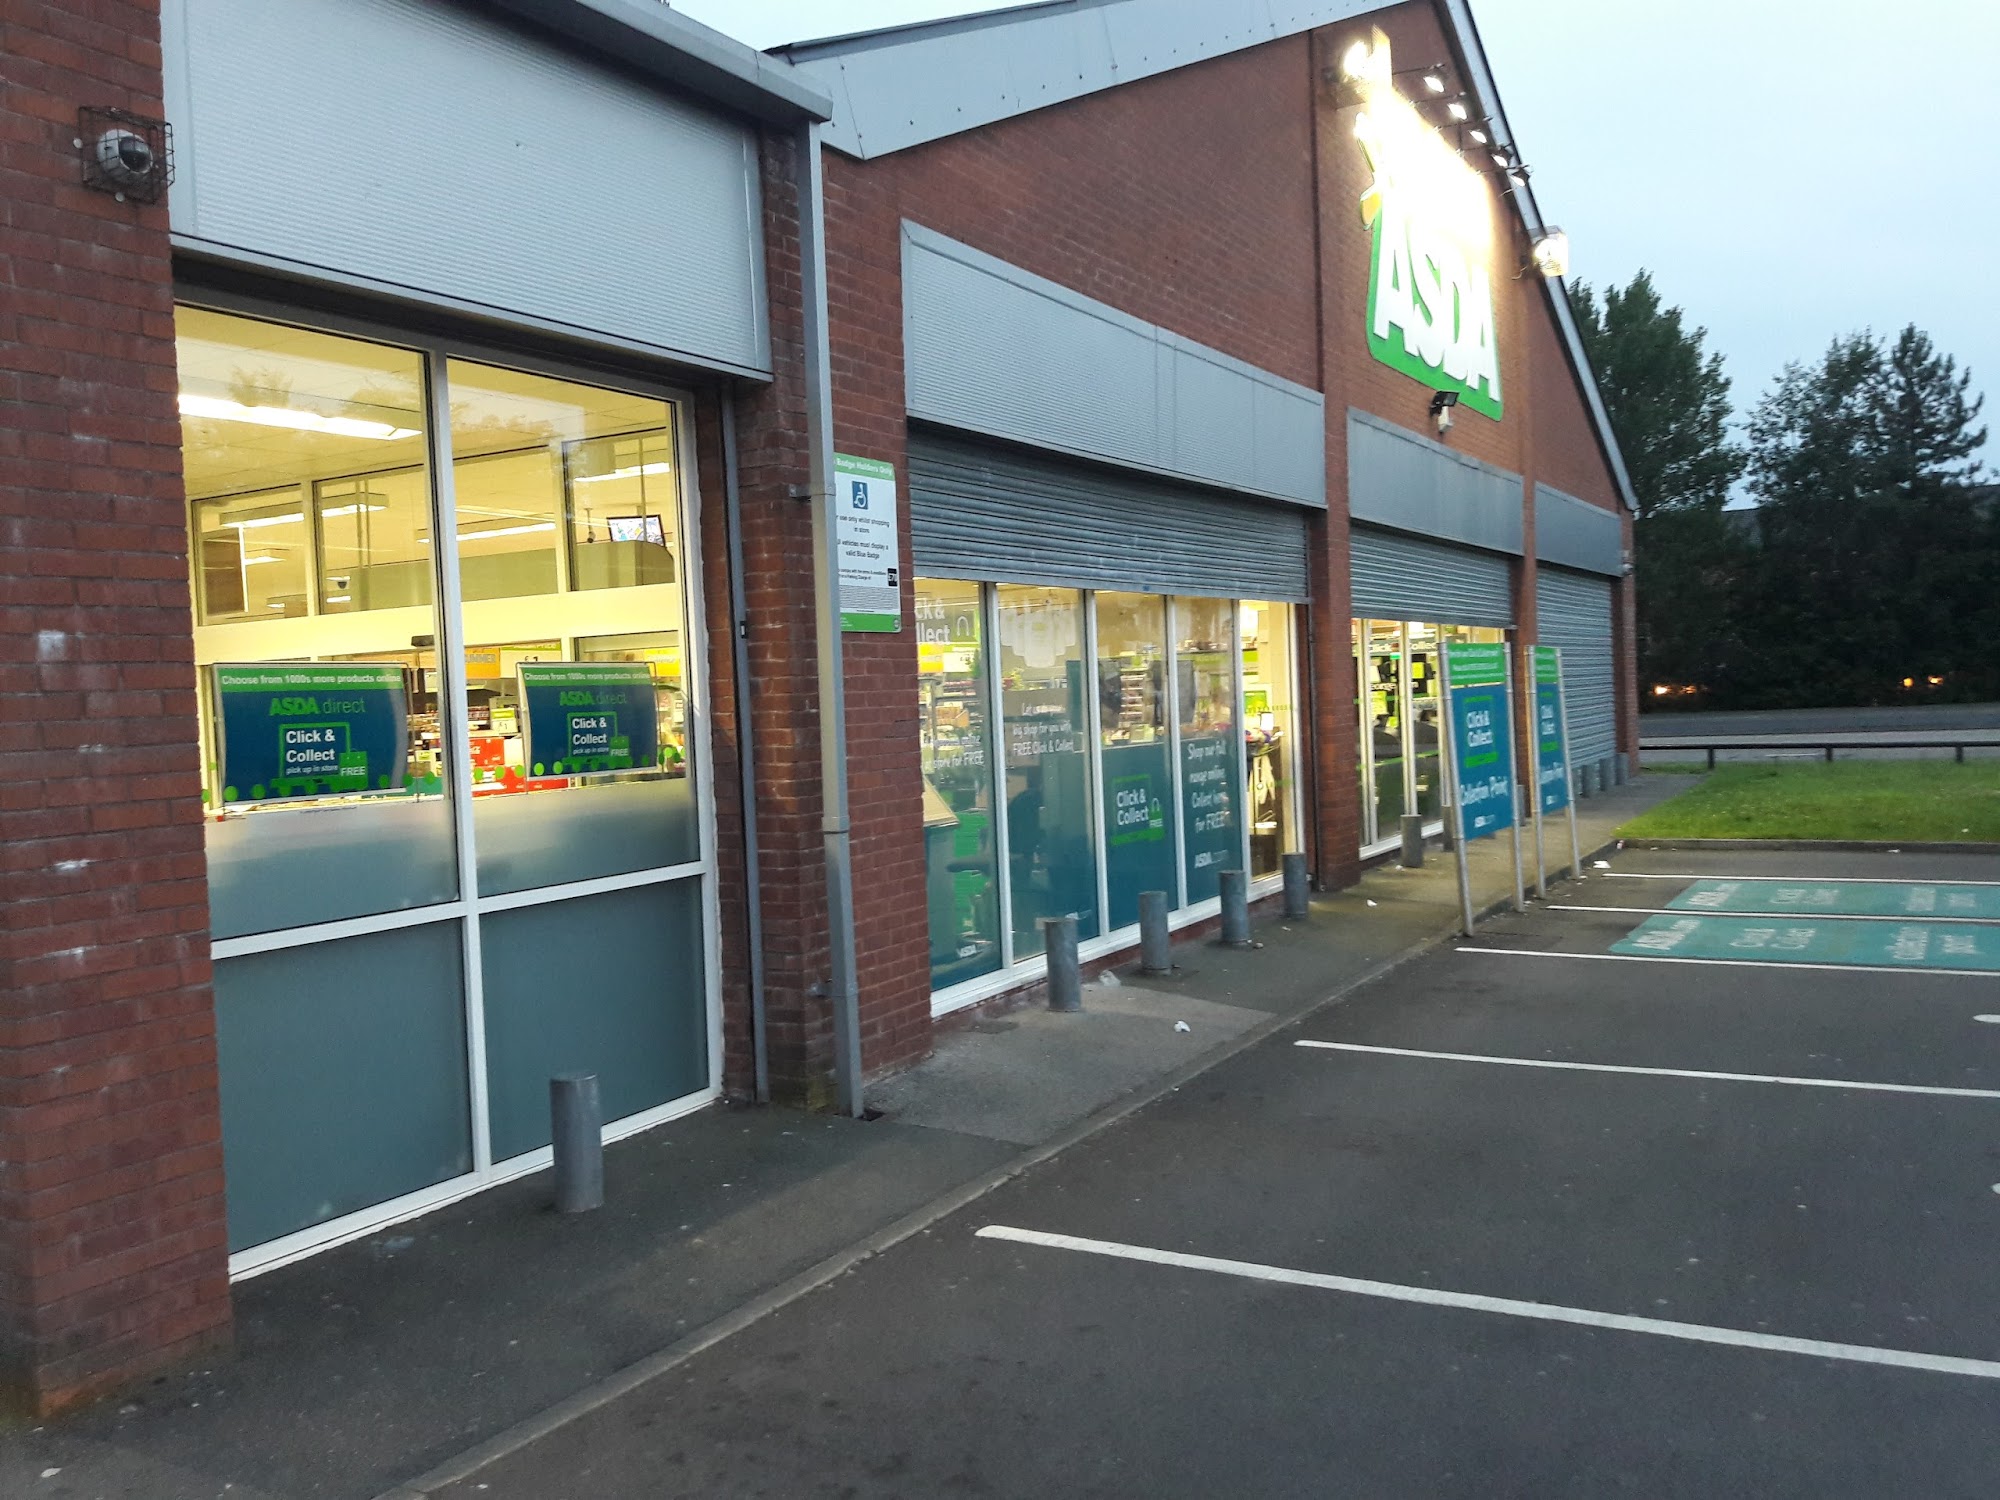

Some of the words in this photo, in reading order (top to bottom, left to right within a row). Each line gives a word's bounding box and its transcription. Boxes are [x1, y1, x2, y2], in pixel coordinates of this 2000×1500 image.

[1372, 185, 1501, 403] ASDA
[916, 622, 951, 645] llect
[222, 675, 259, 685] Choose
[260, 675, 283, 684] from
[285, 674, 311, 684] 1000s
[337, 675, 375, 685] products
[376, 674, 401, 682] online
[524, 672, 550, 681] Choose
[550, 672, 566, 680] from
[604, 673, 631, 681] products
[632, 672, 651, 680] online
[269, 696, 321, 716] ASDA
[322, 697, 366, 714] direct
[559, 690, 595, 706] ASDA
[572, 718, 597, 729] Click
[599, 717, 607, 728] &
[286, 730, 321, 744] Click
[324, 729, 335, 742] &
[572, 733, 607, 746] Collect
[1467, 729, 1493, 748] Collect
[610, 748, 629, 757] FREE
[1013, 741, 1033, 756] FREE
[1048, 739, 1054, 753] &
[1055, 738, 1074, 752] Collect
[286, 748, 336, 763] Collect
[963, 750, 984, 767] FREE
[340, 766, 366, 776] FREE
[1116, 789, 1139, 808] Click
[1139, 788, 1146, 804] &
[1117, 805, 1149, 826] Collect
[1206, 810, 1226, 830] FREE
